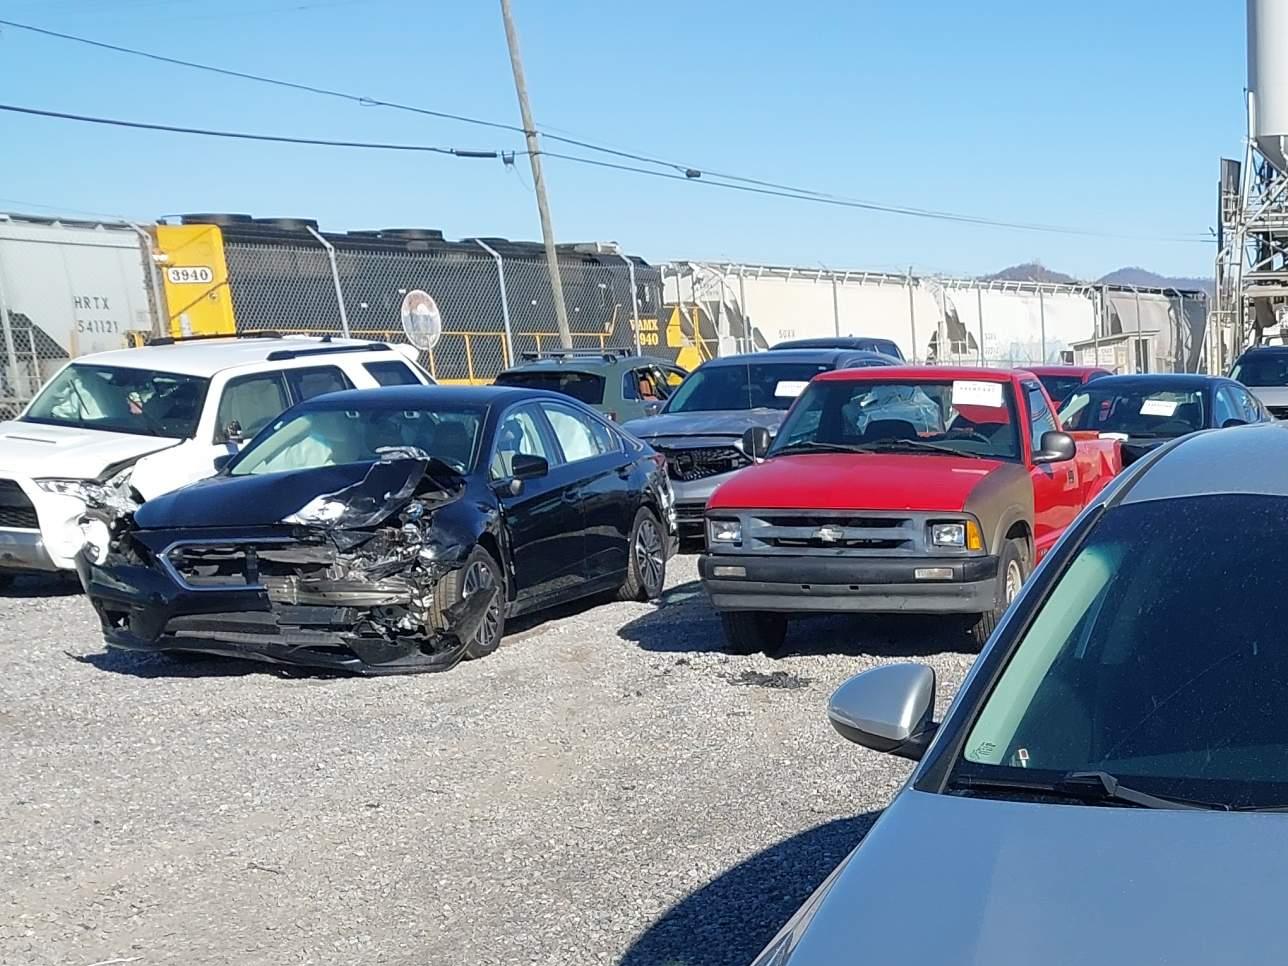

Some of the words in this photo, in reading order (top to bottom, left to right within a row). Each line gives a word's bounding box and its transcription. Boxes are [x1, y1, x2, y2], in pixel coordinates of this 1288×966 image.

[171, 269, 210, 281] 3940
[74, 296, 110, 310] HRTX
[78, 320, 118, 333] 541121
